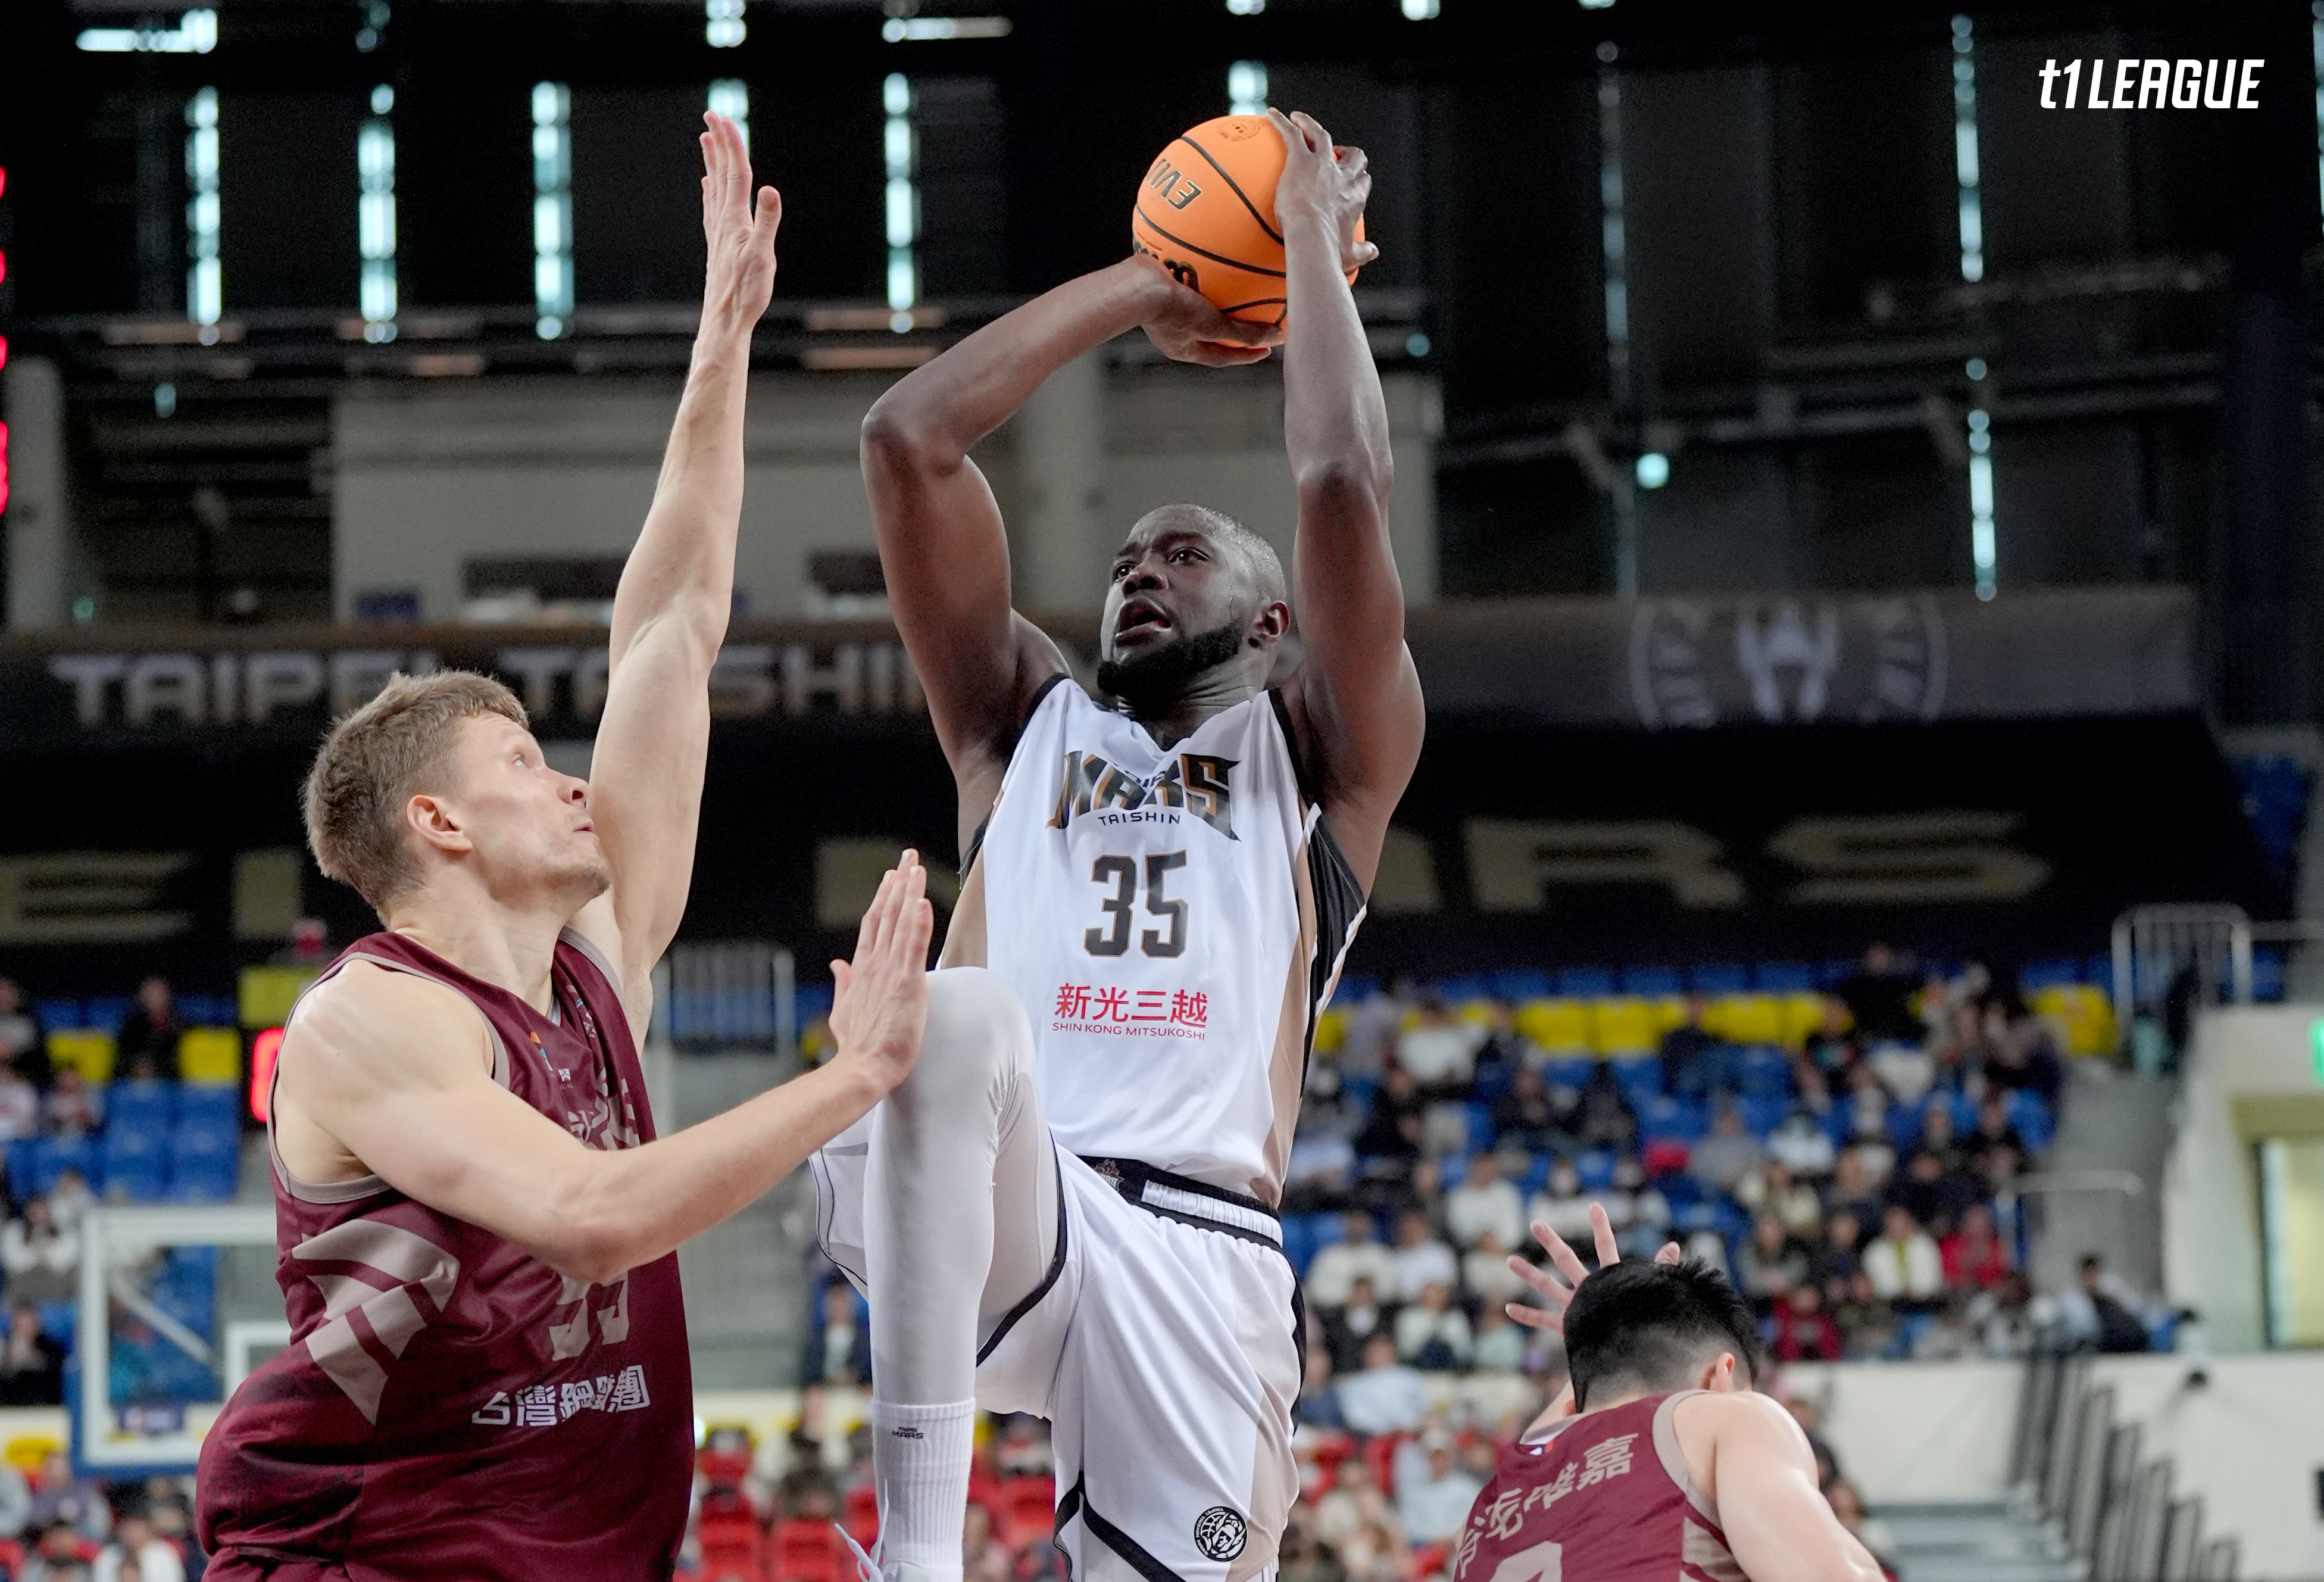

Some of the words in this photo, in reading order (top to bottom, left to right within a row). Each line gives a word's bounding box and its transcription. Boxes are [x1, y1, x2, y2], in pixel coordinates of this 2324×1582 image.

[1098, 811, 1180, 826] TAISHIN
[1083, 849, 1189, 959] 35
[1054, 982, 1208, 1029] 新光三越
[1052, 1022, 1082, 1032] SHIN
[1085, 1024, 1122, 1035] KONG
[1126, 1026, 1205, 1041] MITSUKOSHI
[892, 1430, 924, 1439] MARS
